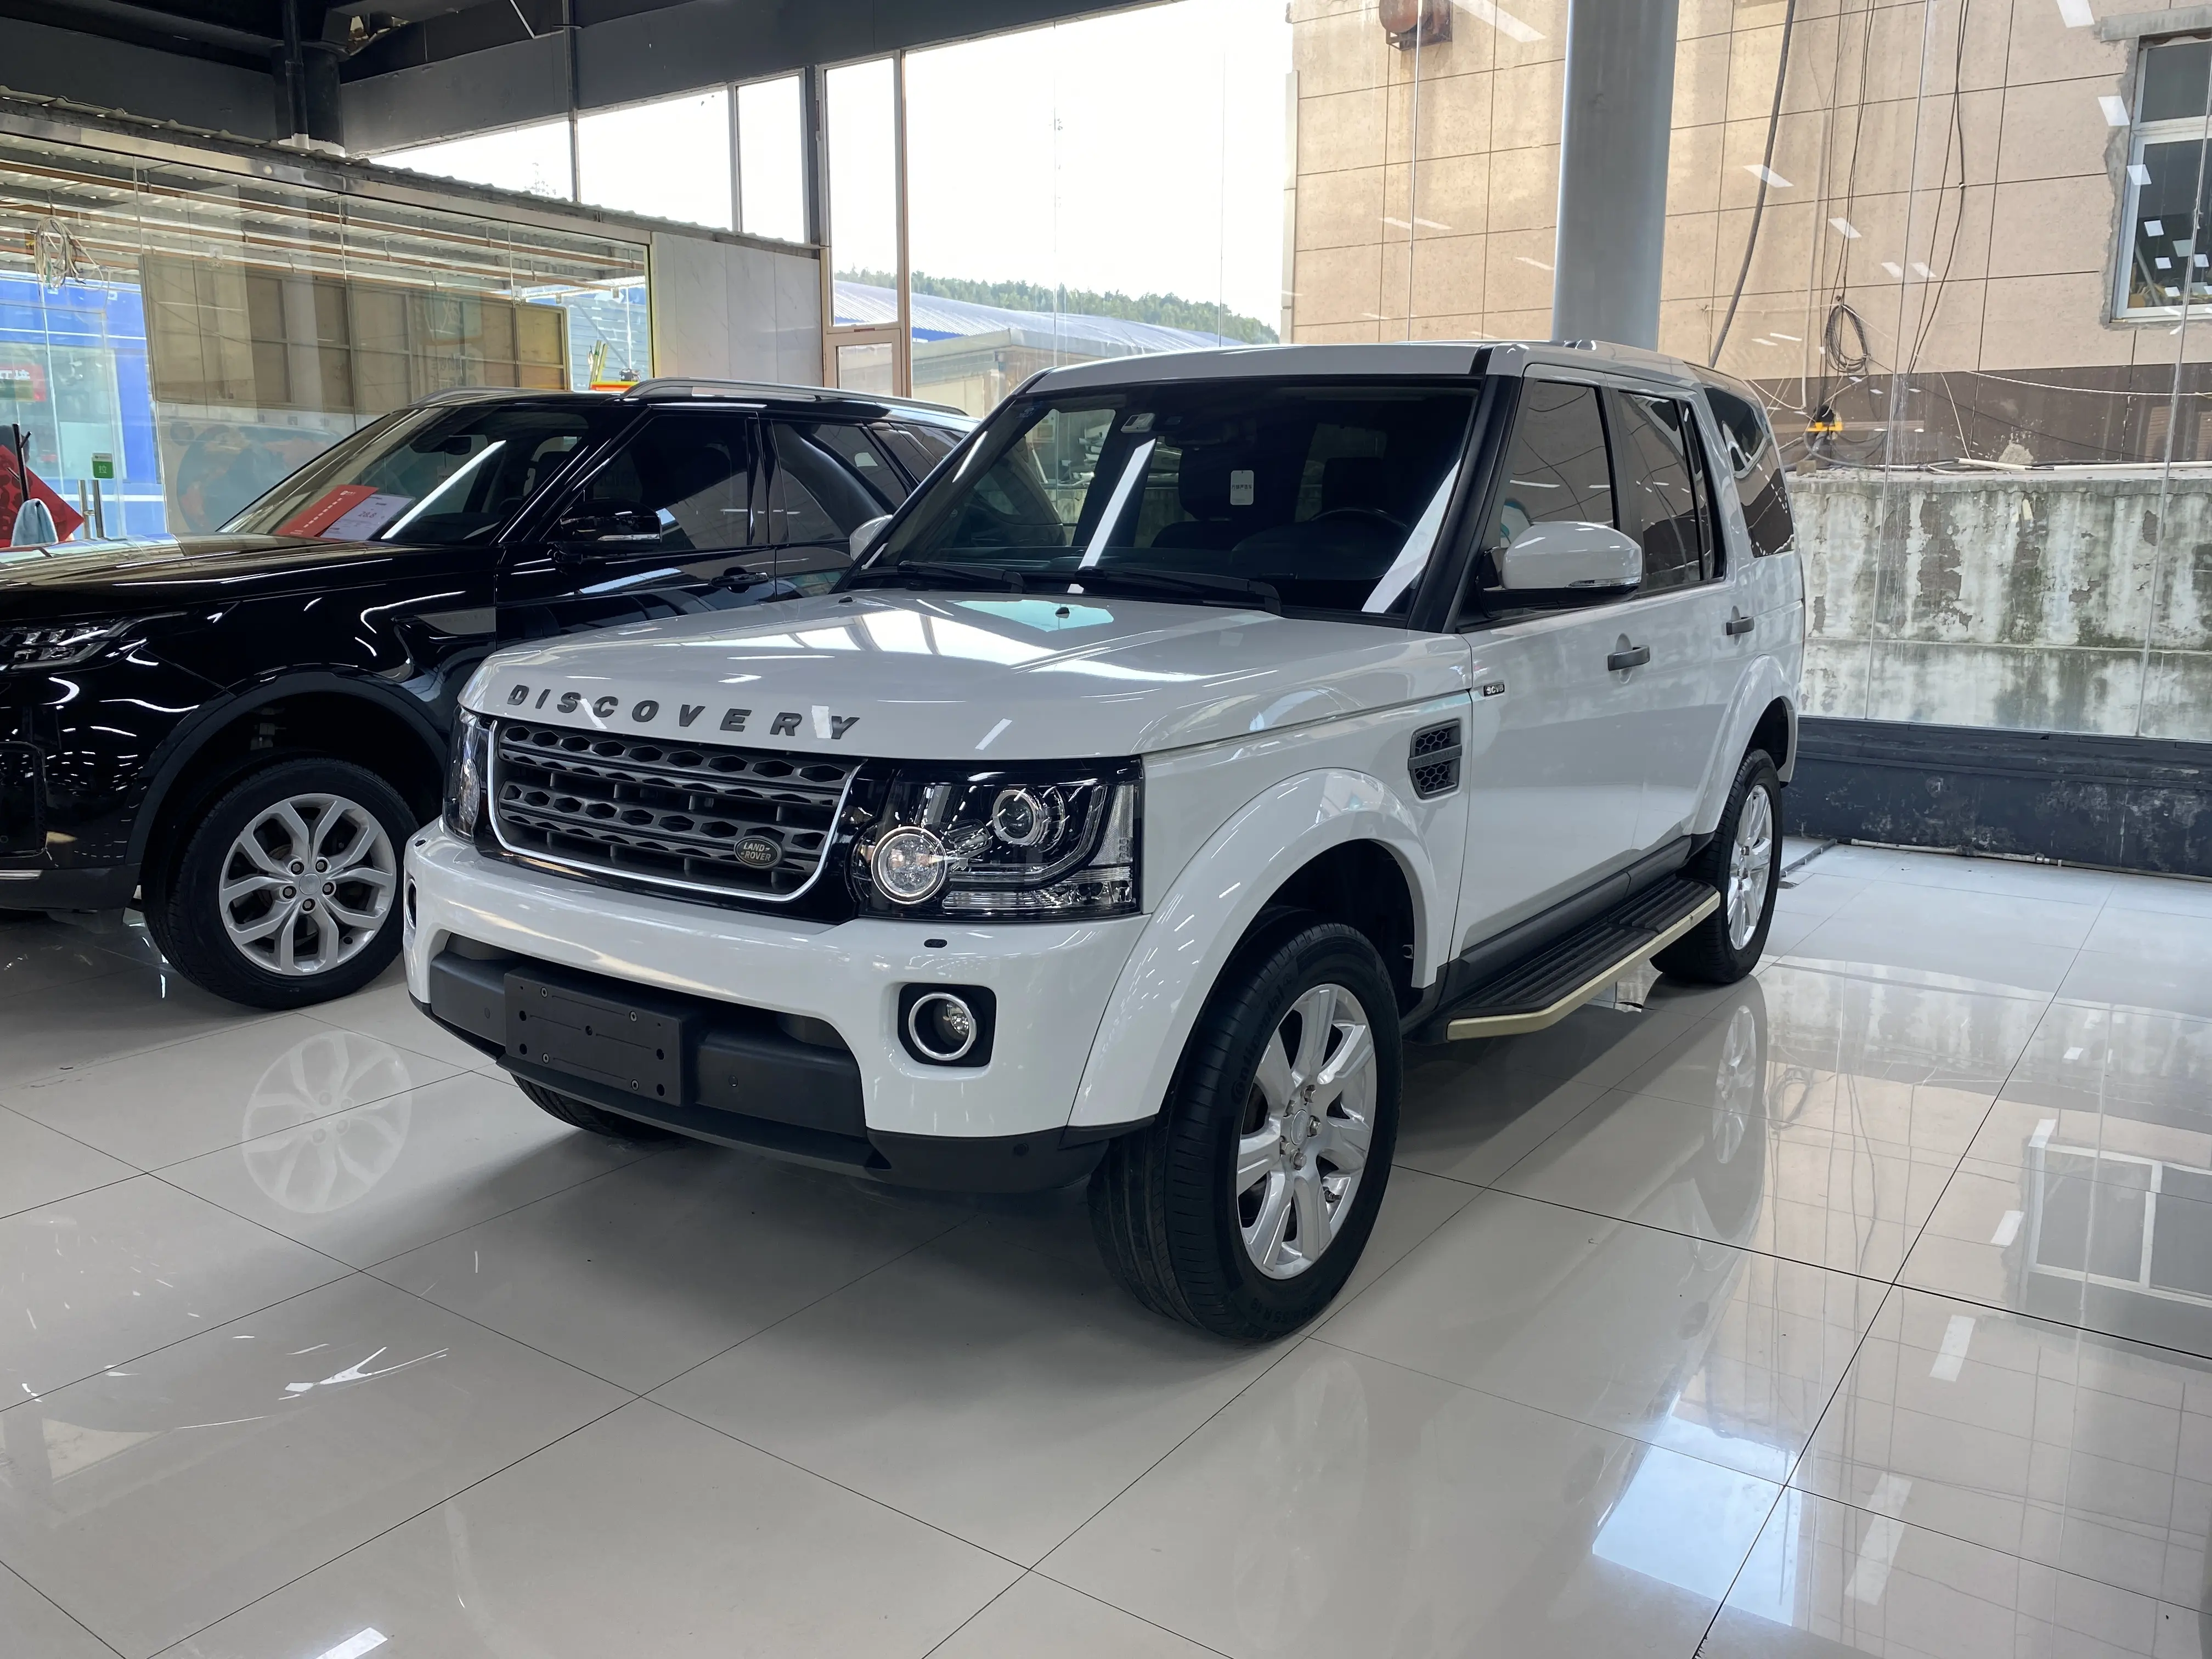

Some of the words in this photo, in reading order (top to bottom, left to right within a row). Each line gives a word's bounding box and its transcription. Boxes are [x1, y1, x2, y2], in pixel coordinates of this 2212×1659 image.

[507, 684, 860, 740] DISCOVERY
[743, 842, 765, 852] LAND
[744, 850, 771, 861] ROVER
